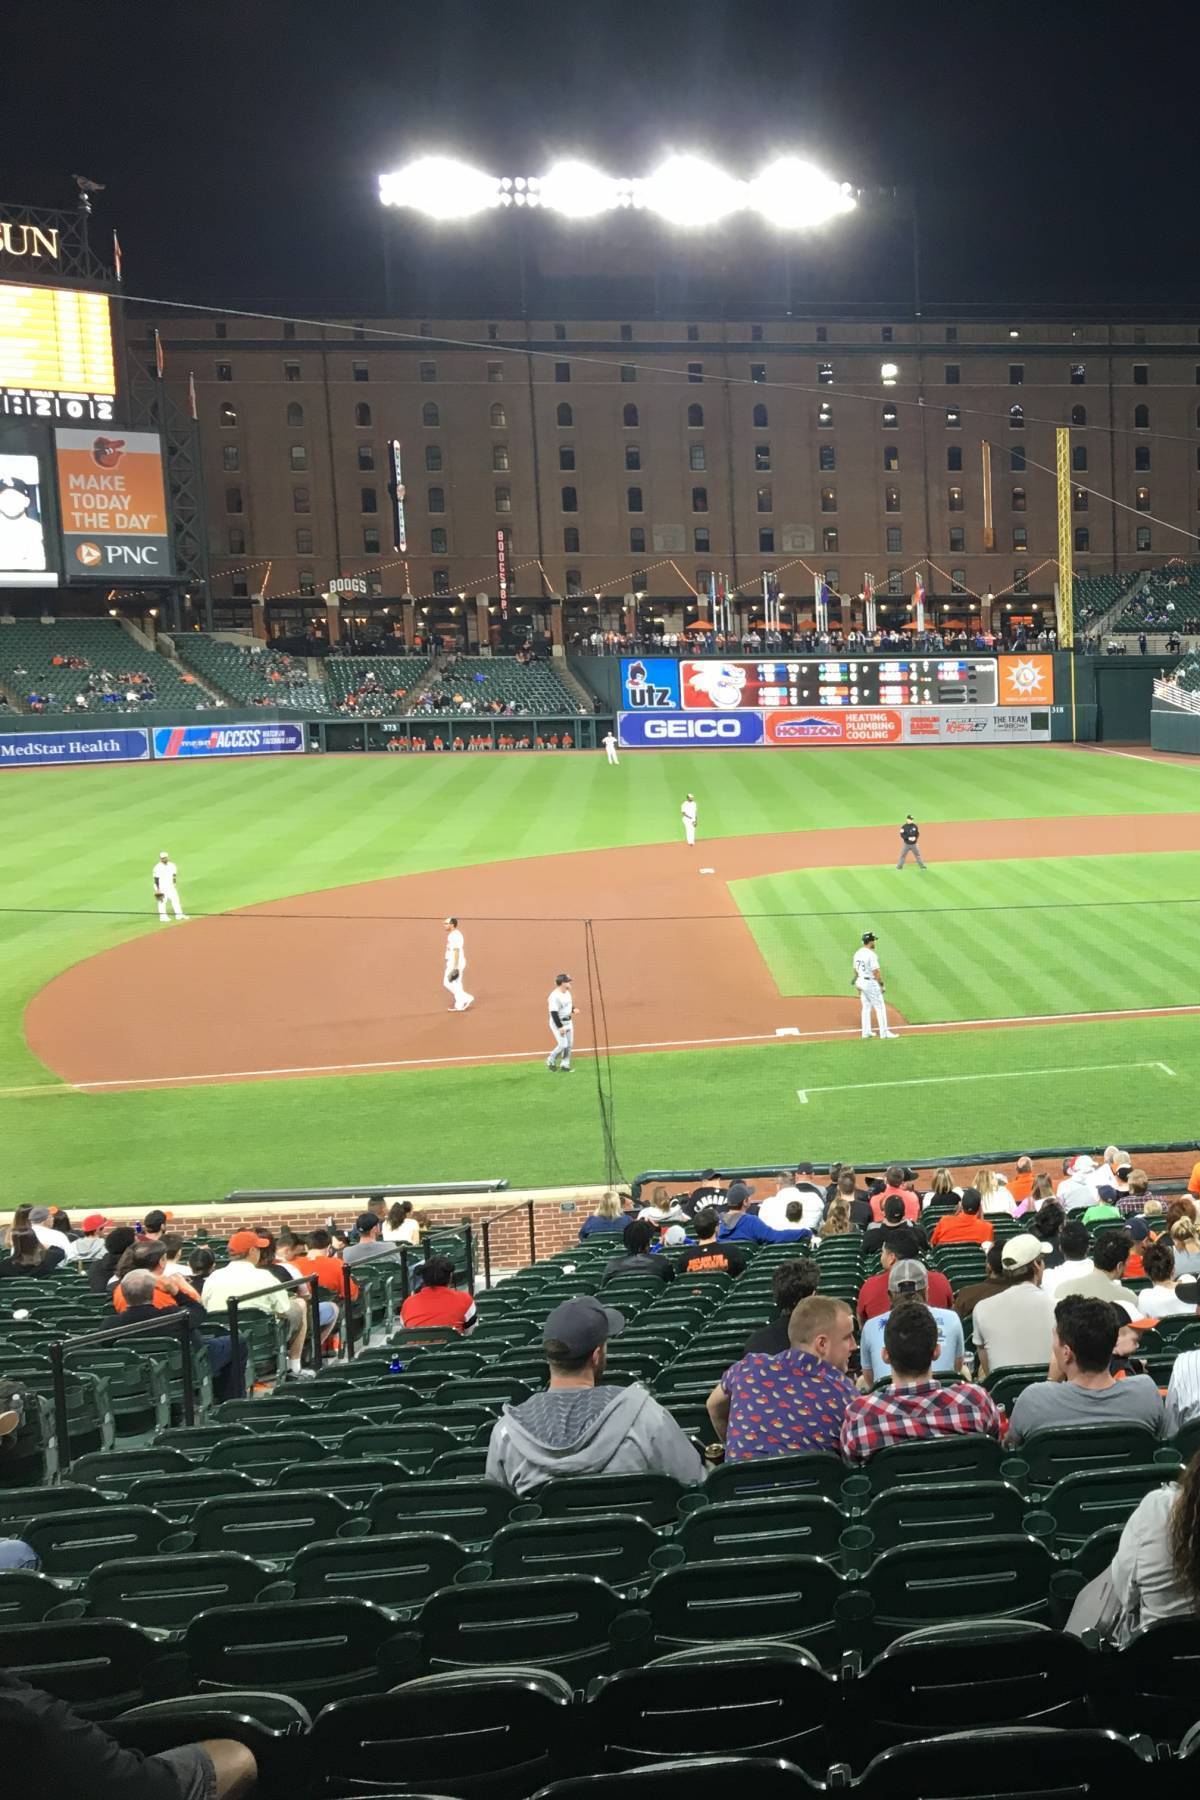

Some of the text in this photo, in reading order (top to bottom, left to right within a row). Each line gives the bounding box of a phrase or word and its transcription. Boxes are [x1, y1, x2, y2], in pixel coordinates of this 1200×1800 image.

[0, 222, 59, 259] UN
[69, 473, 126, 491] MAKE
[69, 492, 132, 511] TODAY
[71, 511, 151, 530] THE DAY
[104, 545, 159, 565] PNC
[845, 713, 887, 722] HEATING
[846, 722, 895, 730] PLUMBING
[993, 716, 1008, 724] THE
[1009, 716, 1028, 724] TEAM
[383, 724, 397, 732] 373
[644, 719, 741, 738] GEICO
[777, 726, 841, 736] HORIZON
[846, 730, 888, 739] COOLING
[216, 729, 260, 748] ACCESS
[1, 739, 120, 757] MedStar Health
